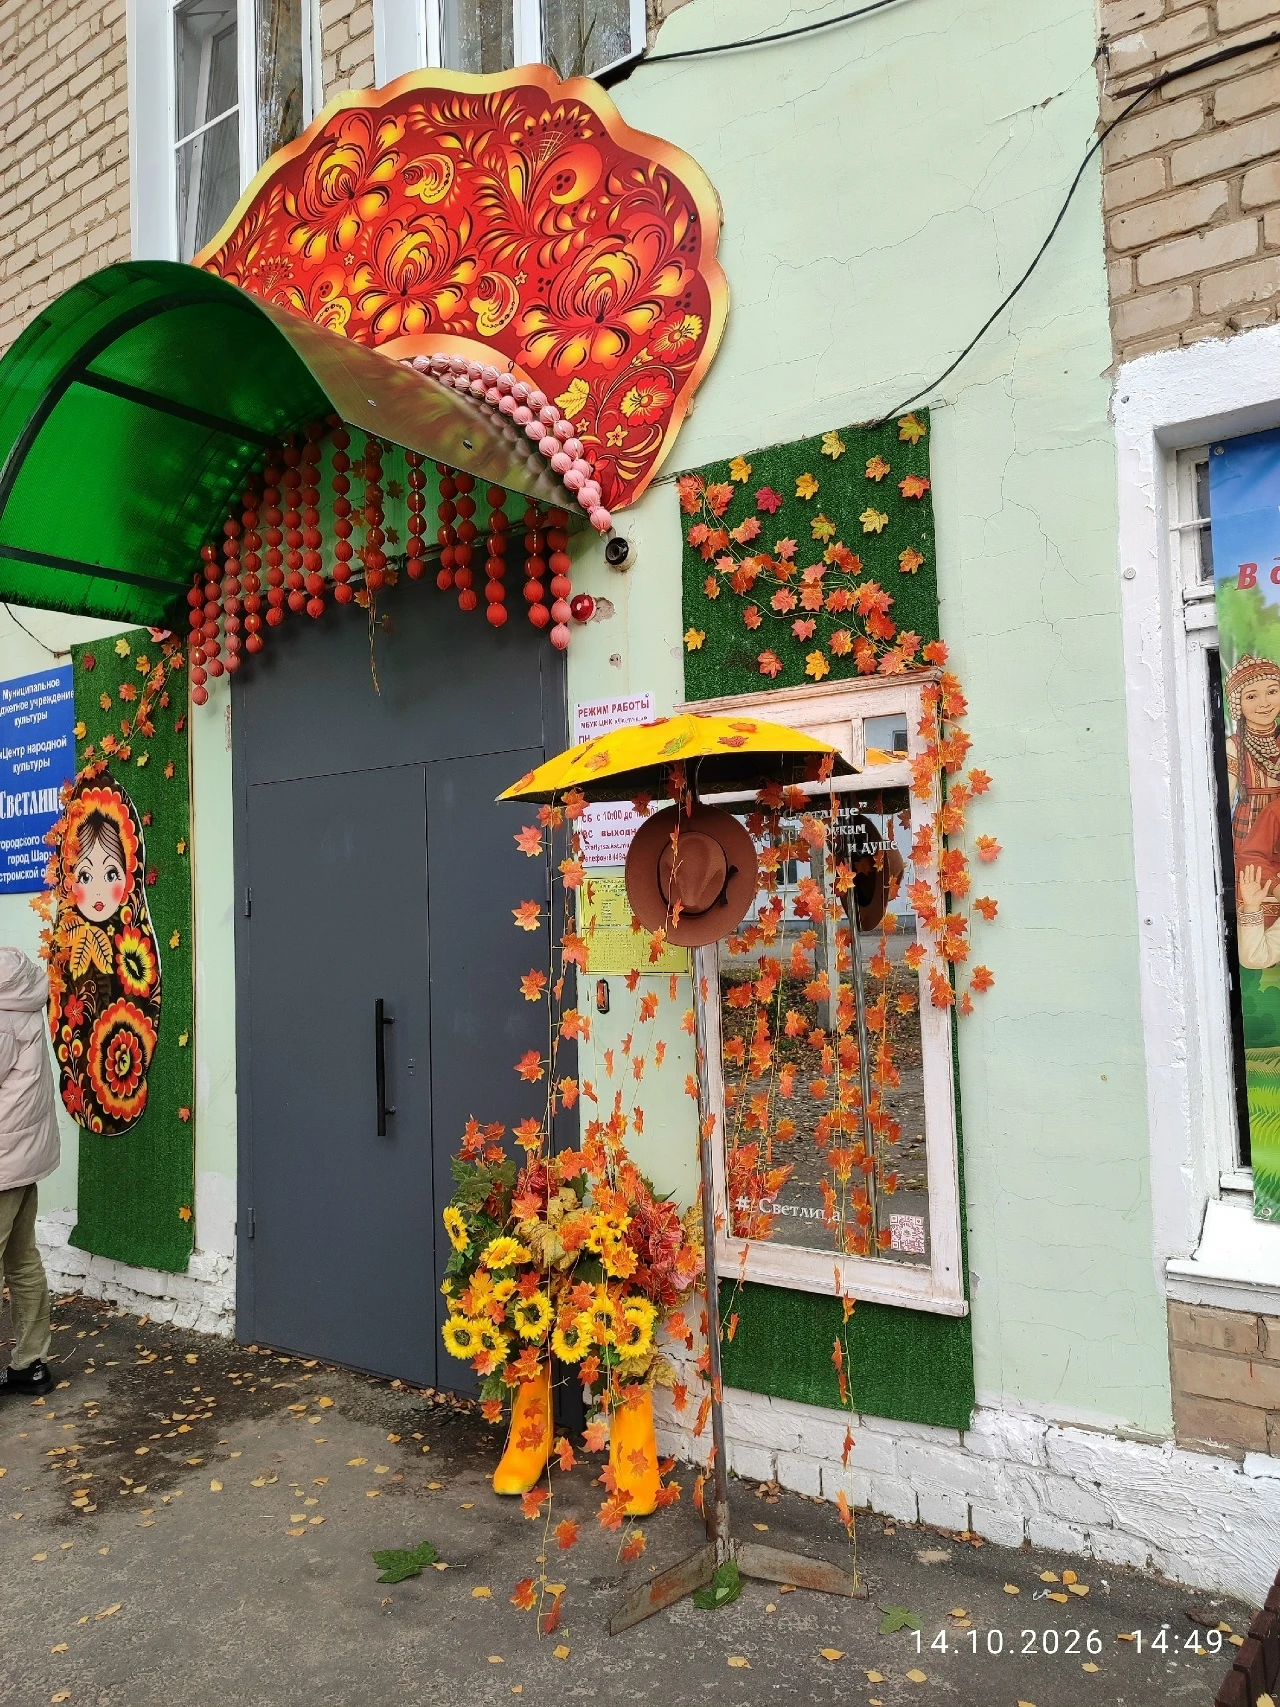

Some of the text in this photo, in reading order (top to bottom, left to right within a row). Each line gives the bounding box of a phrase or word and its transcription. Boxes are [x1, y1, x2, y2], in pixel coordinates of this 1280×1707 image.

[2, 678, 61, 702] Муниципальное
[29, 689, 75, 711] учреждение
[578, 699, 650, 718] РЕЖИМ РАБОТЫ
[14, 711, 48, 728] культуры
[27, 735, 67, 755] народной
[13, 757, 51, 775] культуры
[602, 809, 622, 821] 10:00
[861, 840, 898, 856] душе
[8, 853, 30, 867] город
